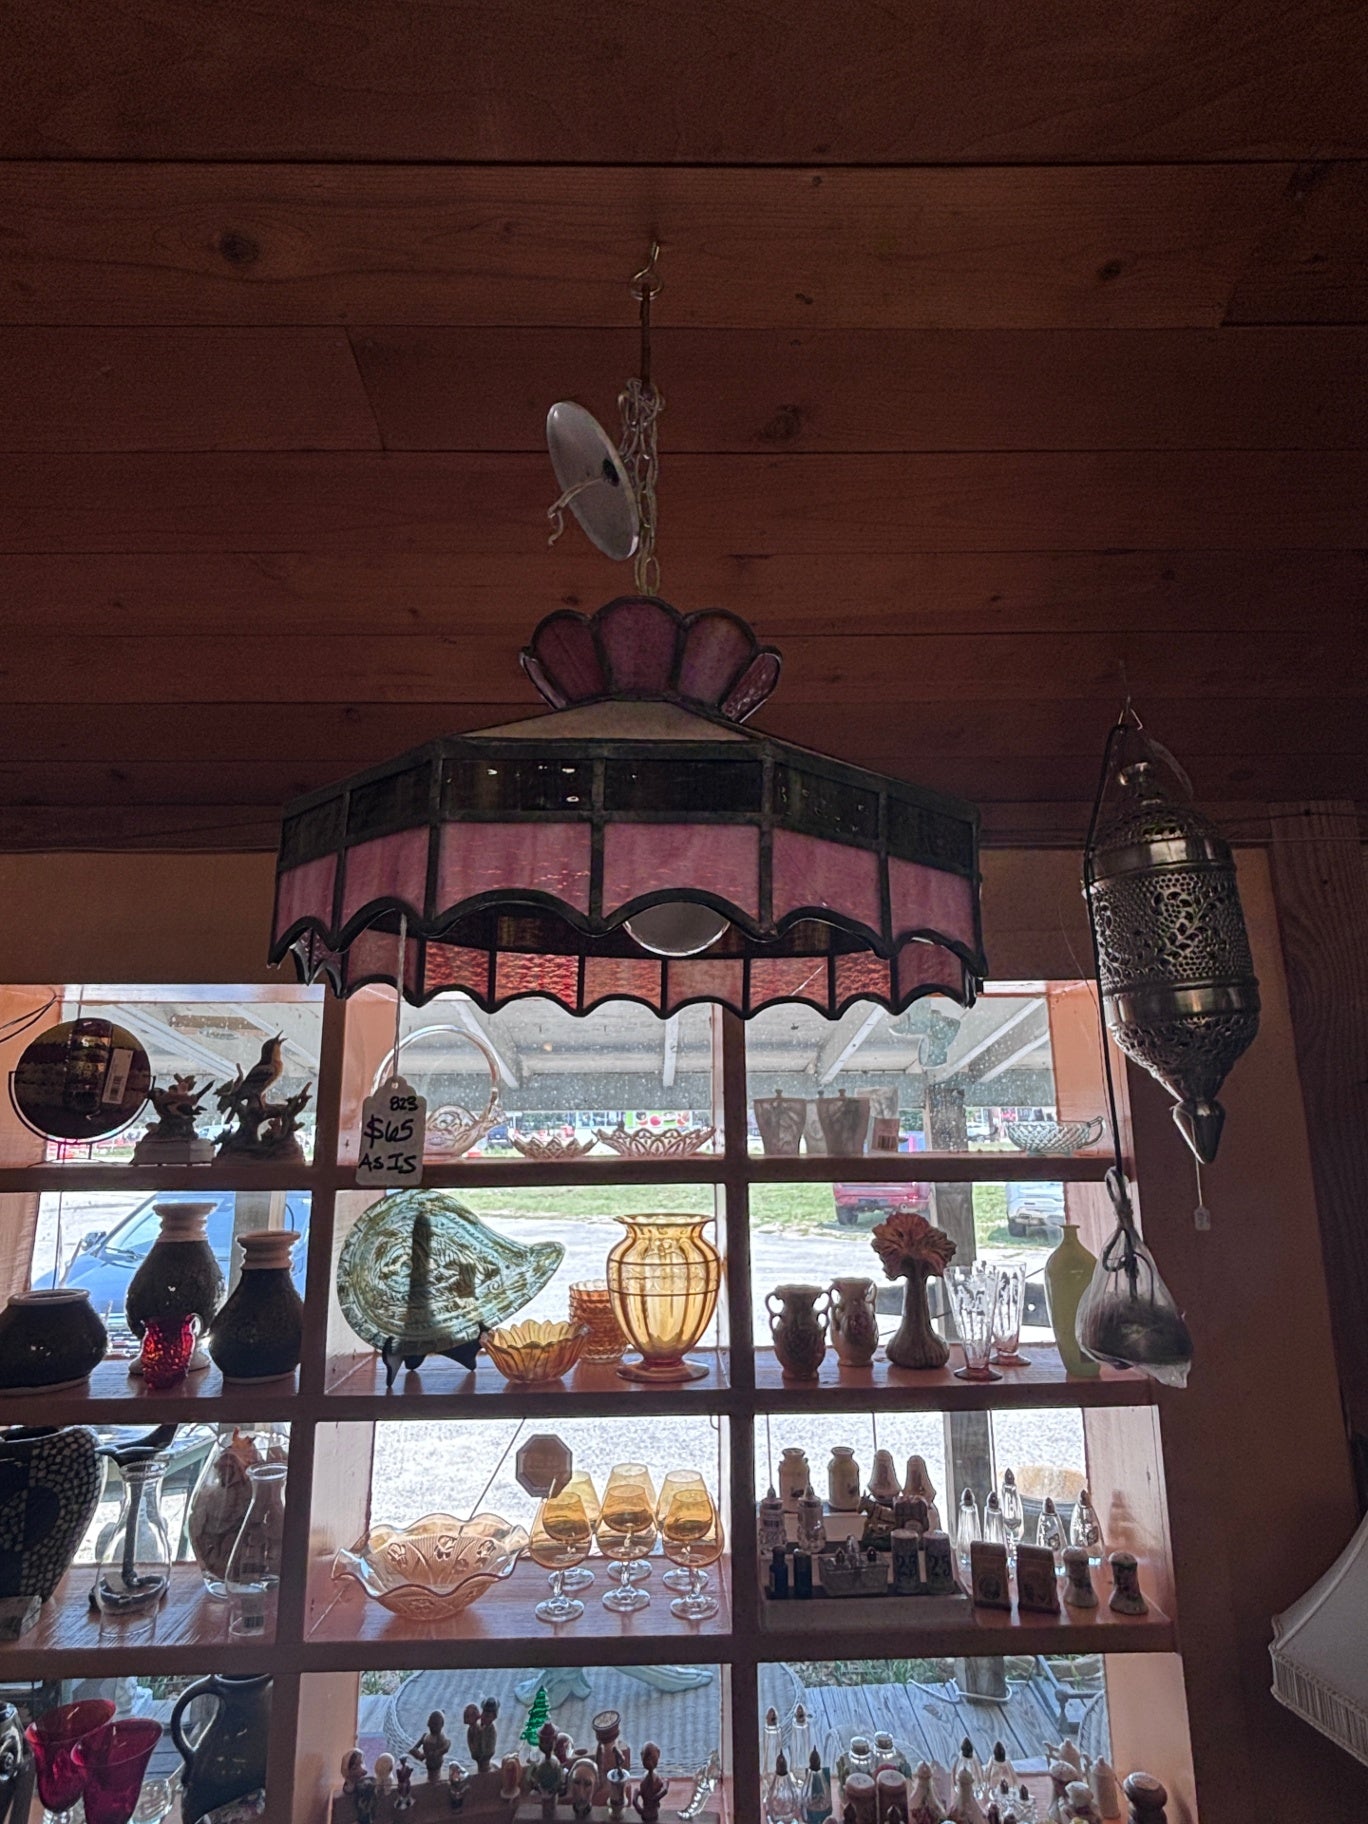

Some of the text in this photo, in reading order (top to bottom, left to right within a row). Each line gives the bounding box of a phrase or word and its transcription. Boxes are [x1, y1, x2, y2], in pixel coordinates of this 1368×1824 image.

[390, 1096, 418, 1111] 823
[364, 1114, 414, 1149] $65
[386, 1153, 417, 1174] IS
